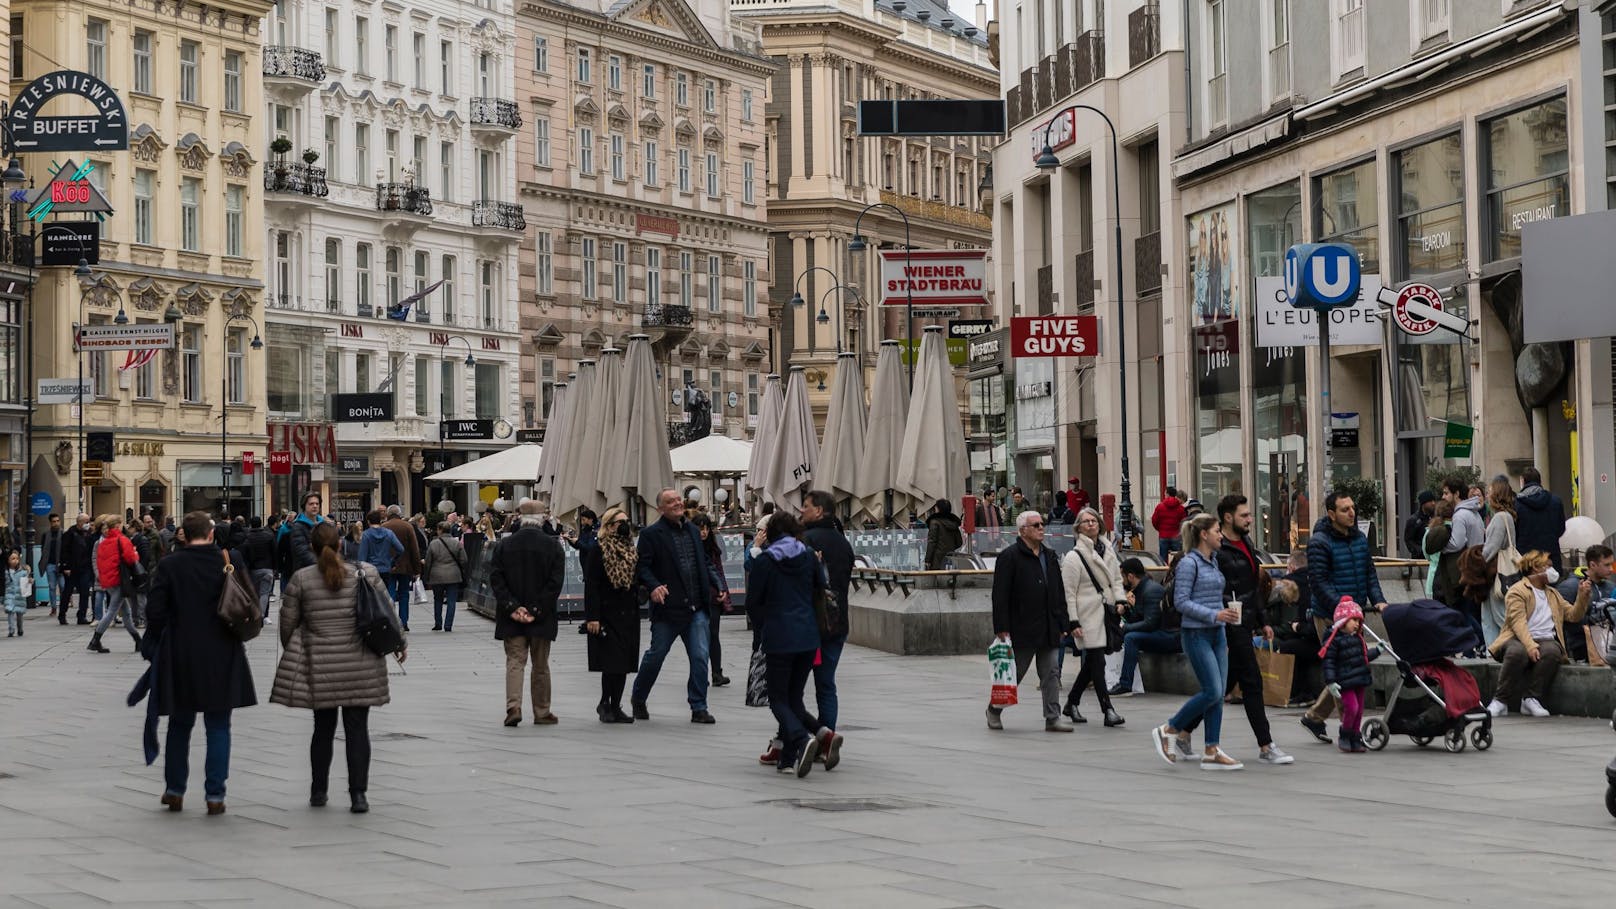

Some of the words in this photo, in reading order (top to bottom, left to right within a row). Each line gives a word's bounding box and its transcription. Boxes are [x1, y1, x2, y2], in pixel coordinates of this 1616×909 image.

[33, 120, 99, 134] BUFFET
[52, 180, 90, 203] Köö
[1421, 231, 1451, 252] TEAROOM
[903, 265, 965, 278] WIENER
[1285, 257, 1298, 300] U
[1312, 255, 1351, 298] U
[887, 278, 983, 292] STADTBRÄU
[1403, 286, 1440, 307] TABAK
[912, 310, 958, 318] RESTAURANT
[1266, 308, 1375, 325] L'EUOPE
[1397, 305, 1432, 332] TRAFIK
[341, 323, 363, 338] LISKA
[951, 324, 987, 334] GERRY
[1030, 319, 1079, 336] FIVE
[429, 332, 450, 346] LISKA
[481, 337, 500, 350] LISKA
[1024, 336, 1086, 354] GUYS
[1206, 345, 1230, 377] Jones
[458, 422, 478, 432] IWC
